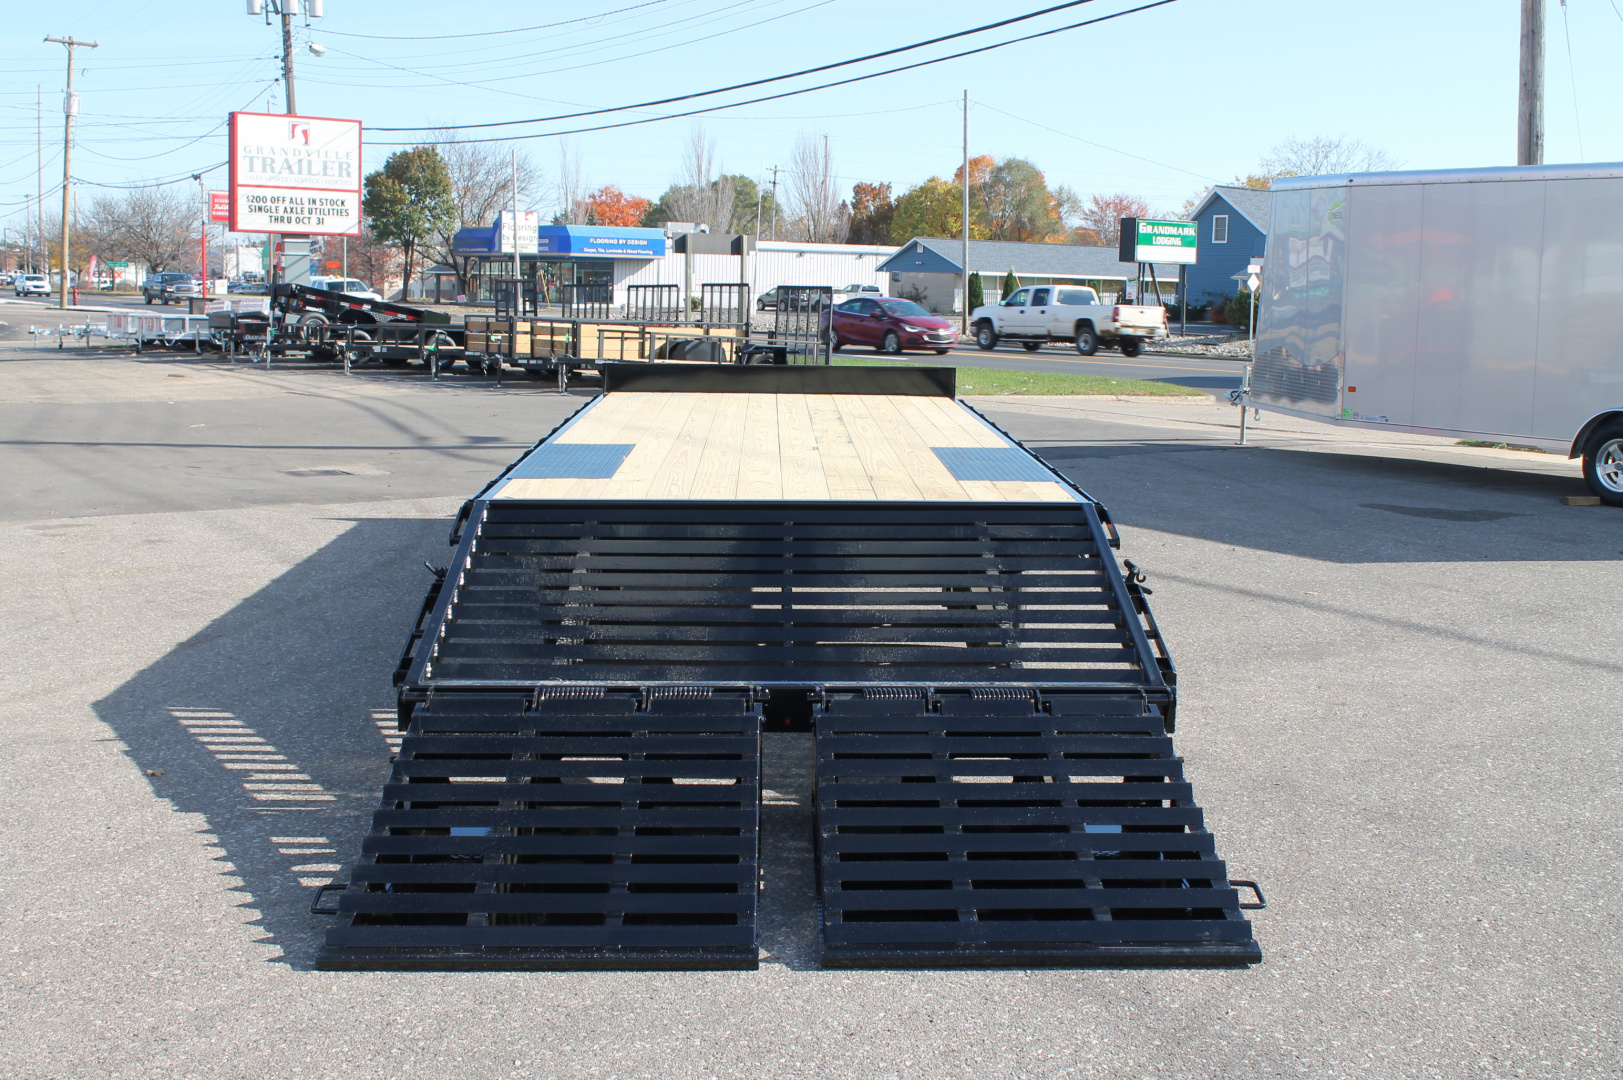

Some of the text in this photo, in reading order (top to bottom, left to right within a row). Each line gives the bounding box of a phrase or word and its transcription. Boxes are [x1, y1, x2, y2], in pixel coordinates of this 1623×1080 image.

[243, 145, 353, 160] GRANDVILLE
[243, 156, 352, 178] TRAILER
[246, 195, 346, 207] $200 OFF ALL IN STOCK
[248, 204, 350, 217] SINGLE AXLE UTILITIES
[268, 215, 325, 225] THRU OCT 31
[1138, 222, 1196, 236] GRANDMARK
[502, 234, 510, 243] by
[513, 234, 538, 243] esign
[589, 237, 618, 245] FLOORING
[1152, 236, 1182, 246] LODGING
